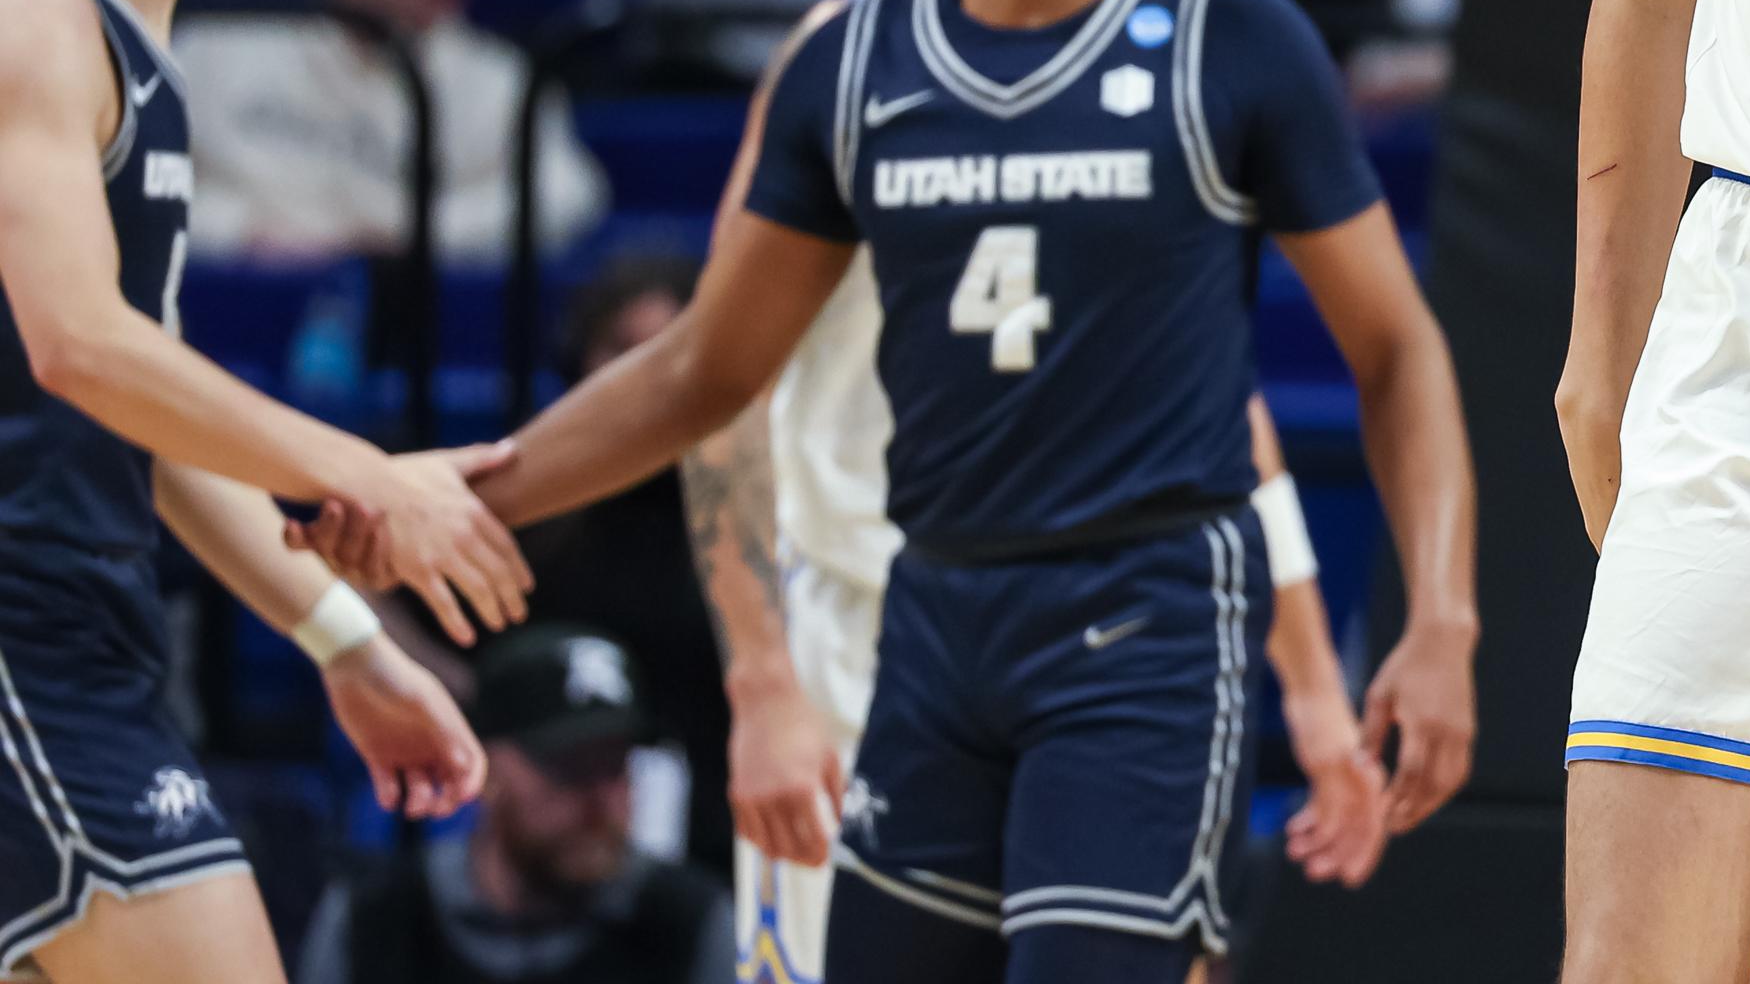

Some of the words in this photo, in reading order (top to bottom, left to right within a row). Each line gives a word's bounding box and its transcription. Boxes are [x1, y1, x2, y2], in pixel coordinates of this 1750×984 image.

[874, 155, 997, 207] UTAH
[999, 150, 1151, 201] STATE
[949, 226, 1051, 371] 4
